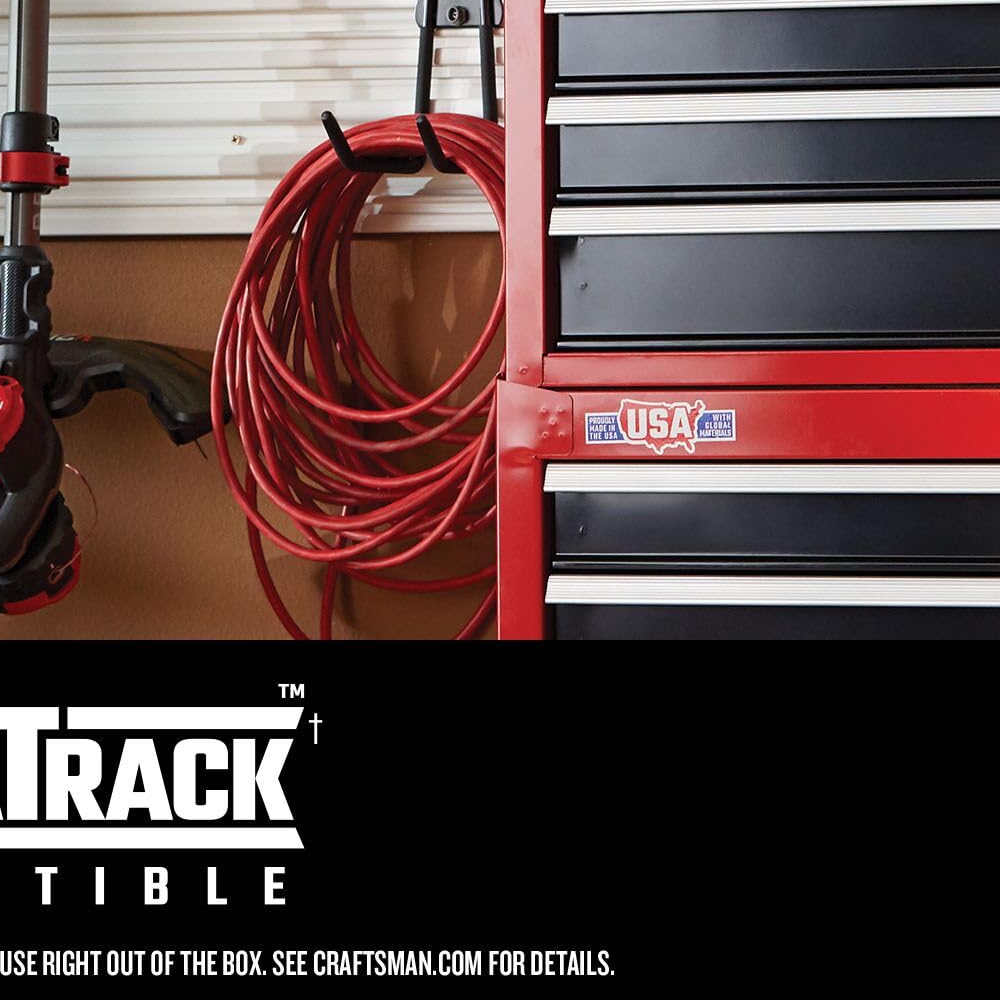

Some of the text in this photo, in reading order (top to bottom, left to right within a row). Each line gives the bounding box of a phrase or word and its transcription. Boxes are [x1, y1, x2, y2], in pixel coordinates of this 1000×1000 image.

[588, 416, 616, 424] PROUDLY
[712, 413, 732, 421] WITH
[627, 408, 694, 439] USA
[704, 421, 731, 429] GLOBAL
[589, 424, 616, 432] MADE IN
[588, 432, 618, 440] THE USA
[699, 429, 732, 437] MATERIALS
